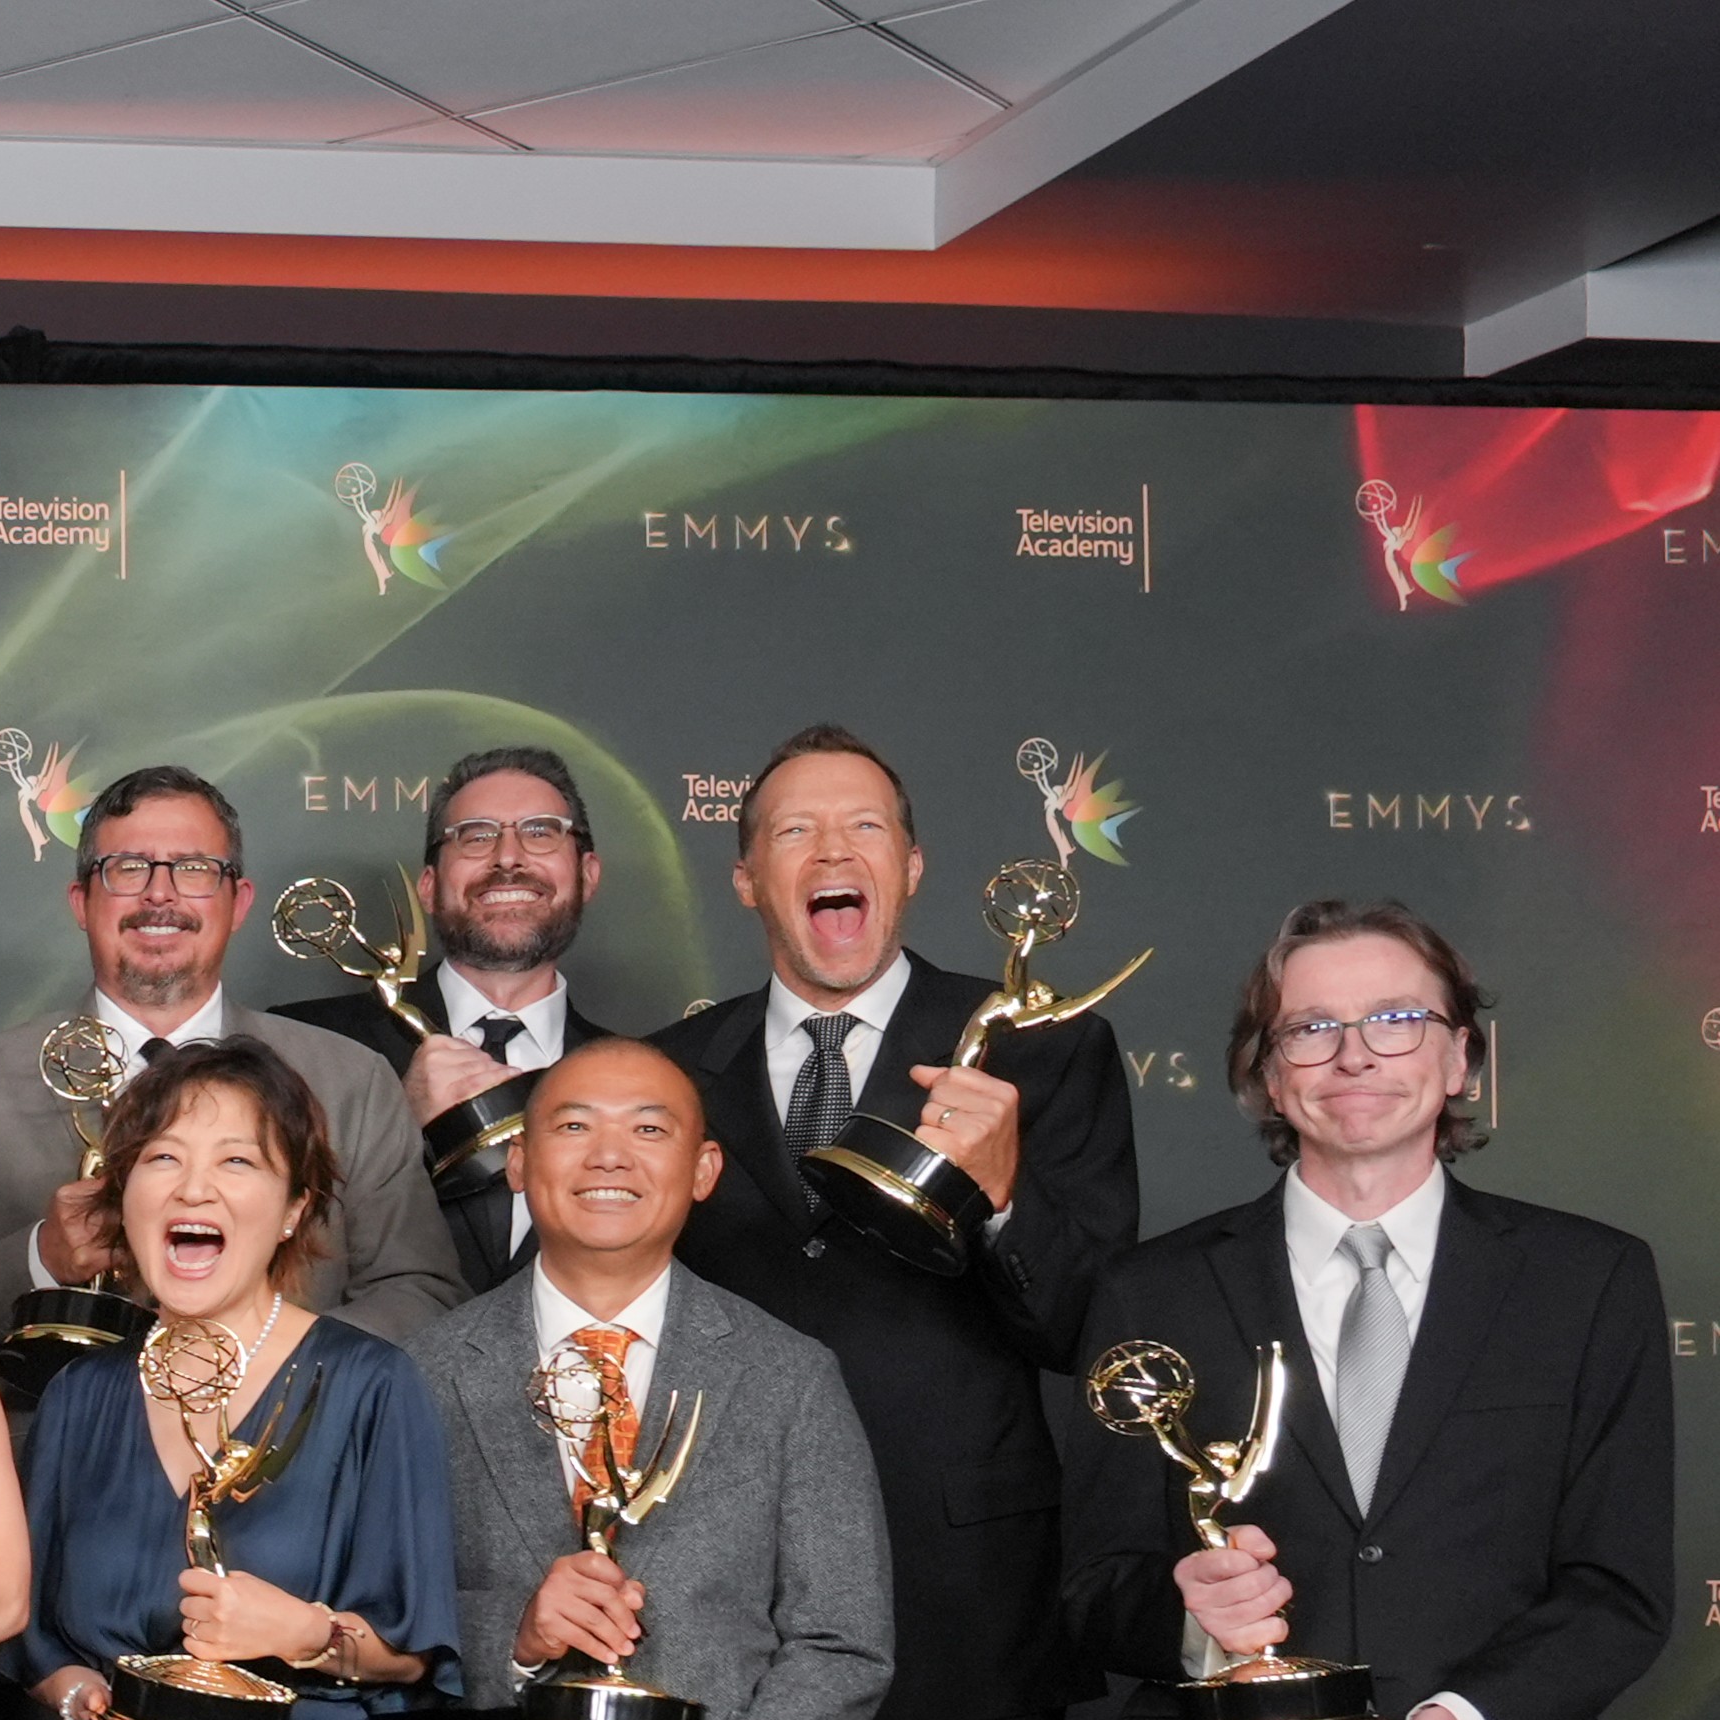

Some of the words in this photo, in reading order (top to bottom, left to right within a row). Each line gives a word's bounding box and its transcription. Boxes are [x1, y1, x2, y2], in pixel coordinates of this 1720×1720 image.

[644, 512, 852, 553] EMMYS
[1016, 509, 1133, 533] Television
[1016, 533, 1133, 565] Academy
[303, 775, 433, 813] EMM
[682, 774, 754, 798] Televi
[1327, 793, 1533, 832] EMMYS
